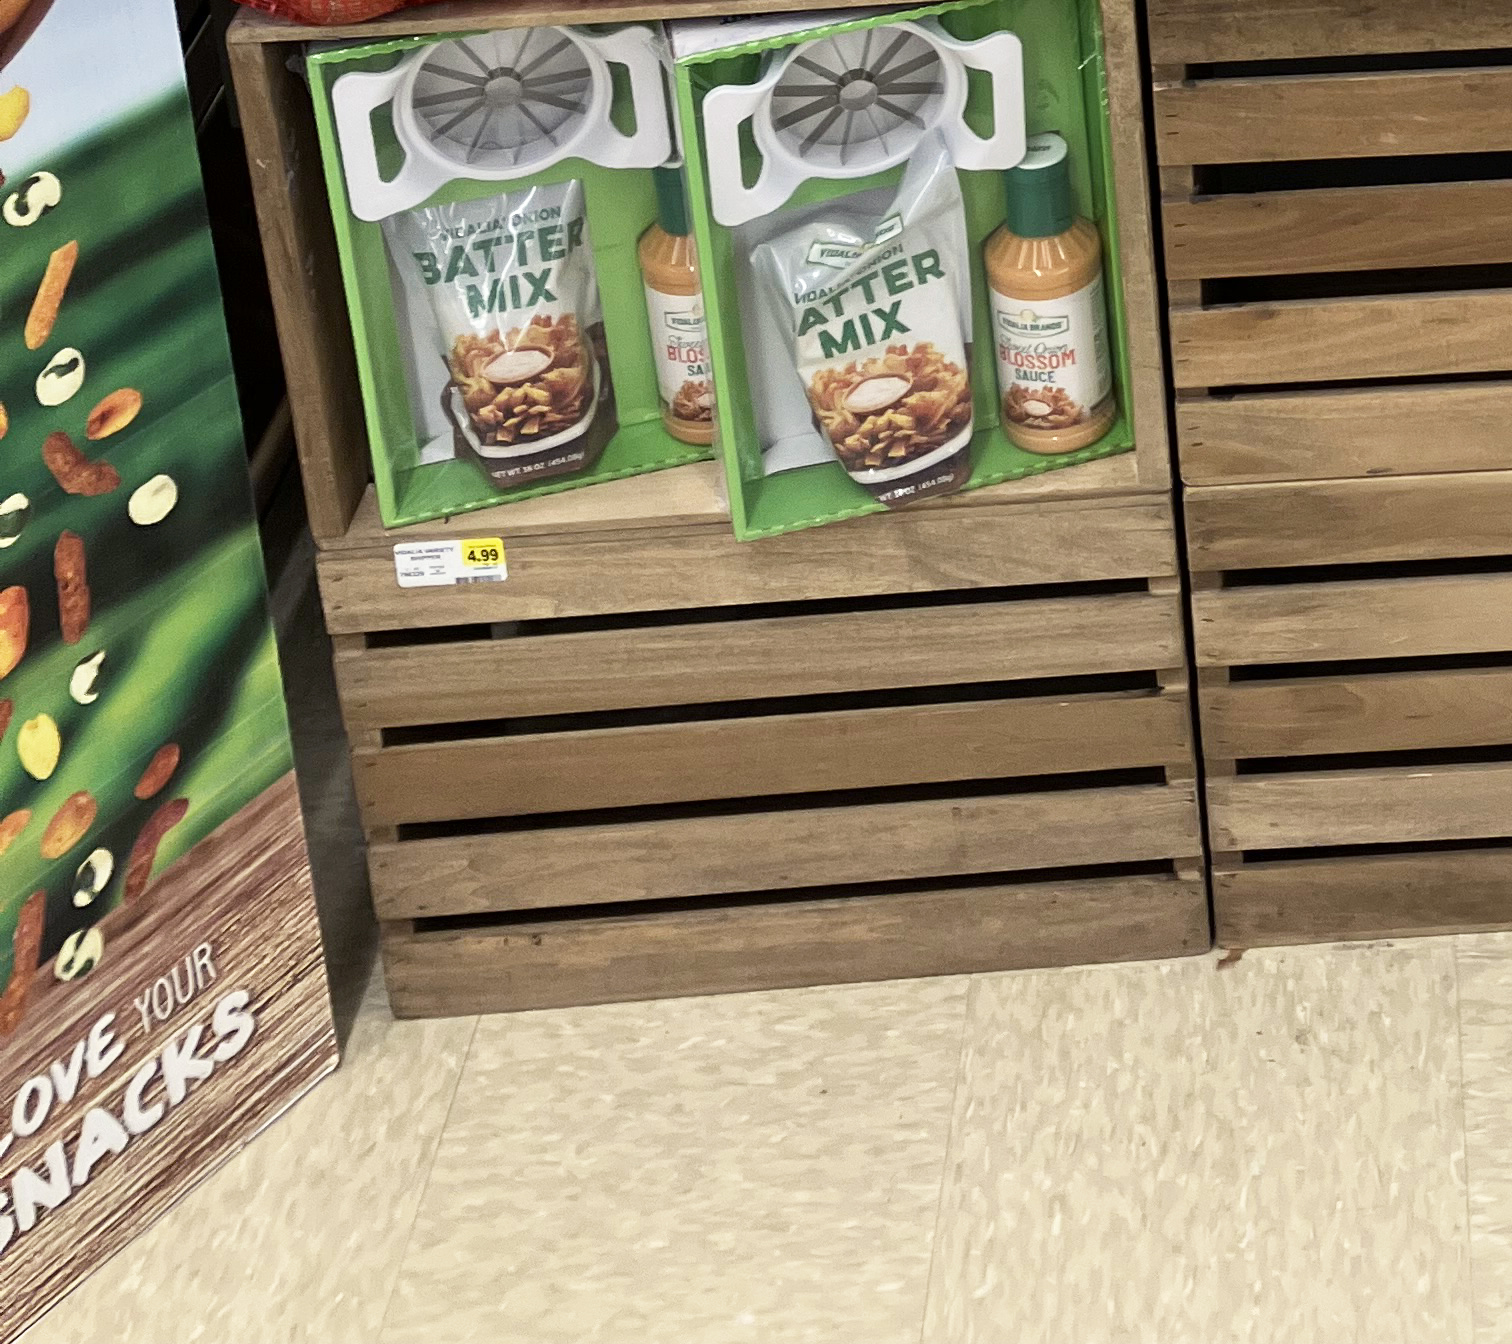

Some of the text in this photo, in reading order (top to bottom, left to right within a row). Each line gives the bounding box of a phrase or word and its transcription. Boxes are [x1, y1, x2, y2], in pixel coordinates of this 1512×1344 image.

[511, 205, 562, 229] ONION
[413, 216, 585, 286] BATTER
[464, 267, 559, 320] MIX
[797, 247, 946, 338] ATTER
[818, 299, 912, 360] MIX
[1030, 318, 1064, 330] BRANDS
[1000, 351, 1077, 370] BLOSSOM
[1014, 368, 1057, 383] SAUCE
[467, 548, 499, 563] 4.99
[0, 940, 217, 1160] OVE YOUR
